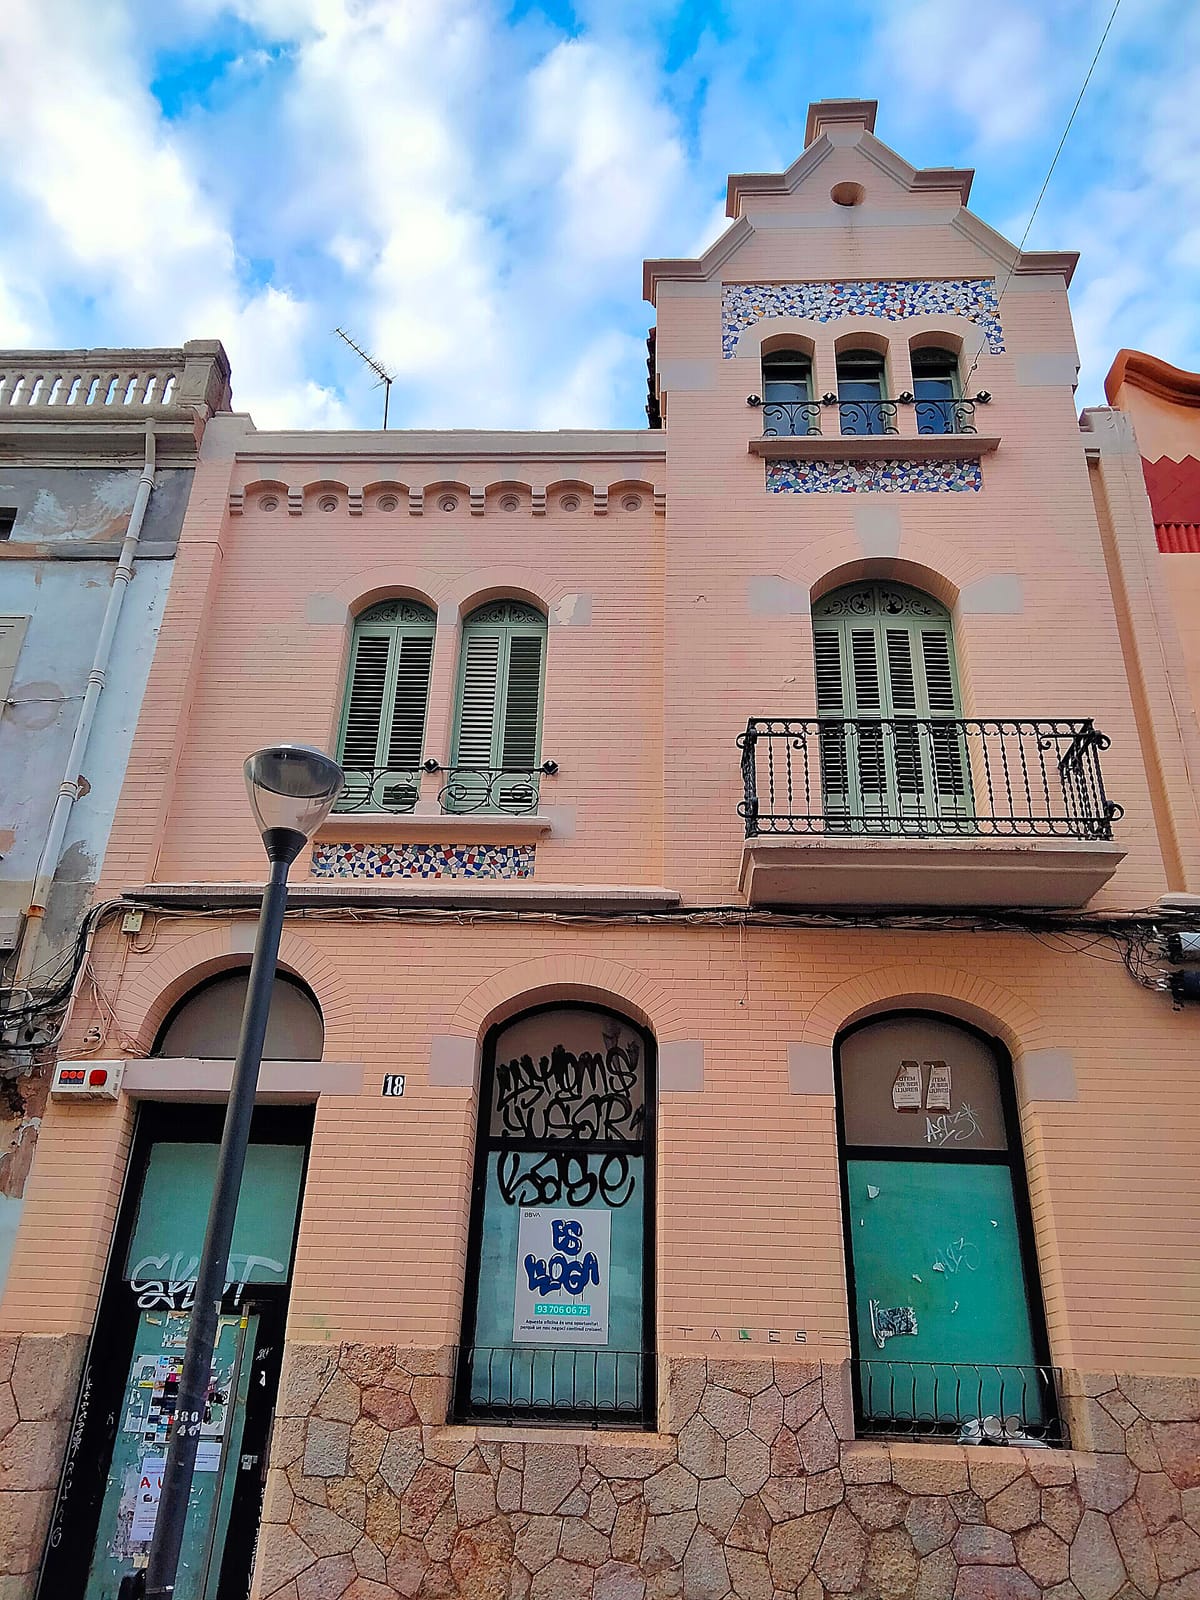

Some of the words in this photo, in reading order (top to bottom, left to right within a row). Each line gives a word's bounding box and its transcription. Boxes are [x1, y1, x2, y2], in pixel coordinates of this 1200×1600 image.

[385, 1075, 404, 1096] 18
[537, 1305, 548, 1313] 93
[549, 1305, 564, 1314] 706
[578, 1306, 588, 1315] 75
[677, 1327, 807, 1343] TALES
